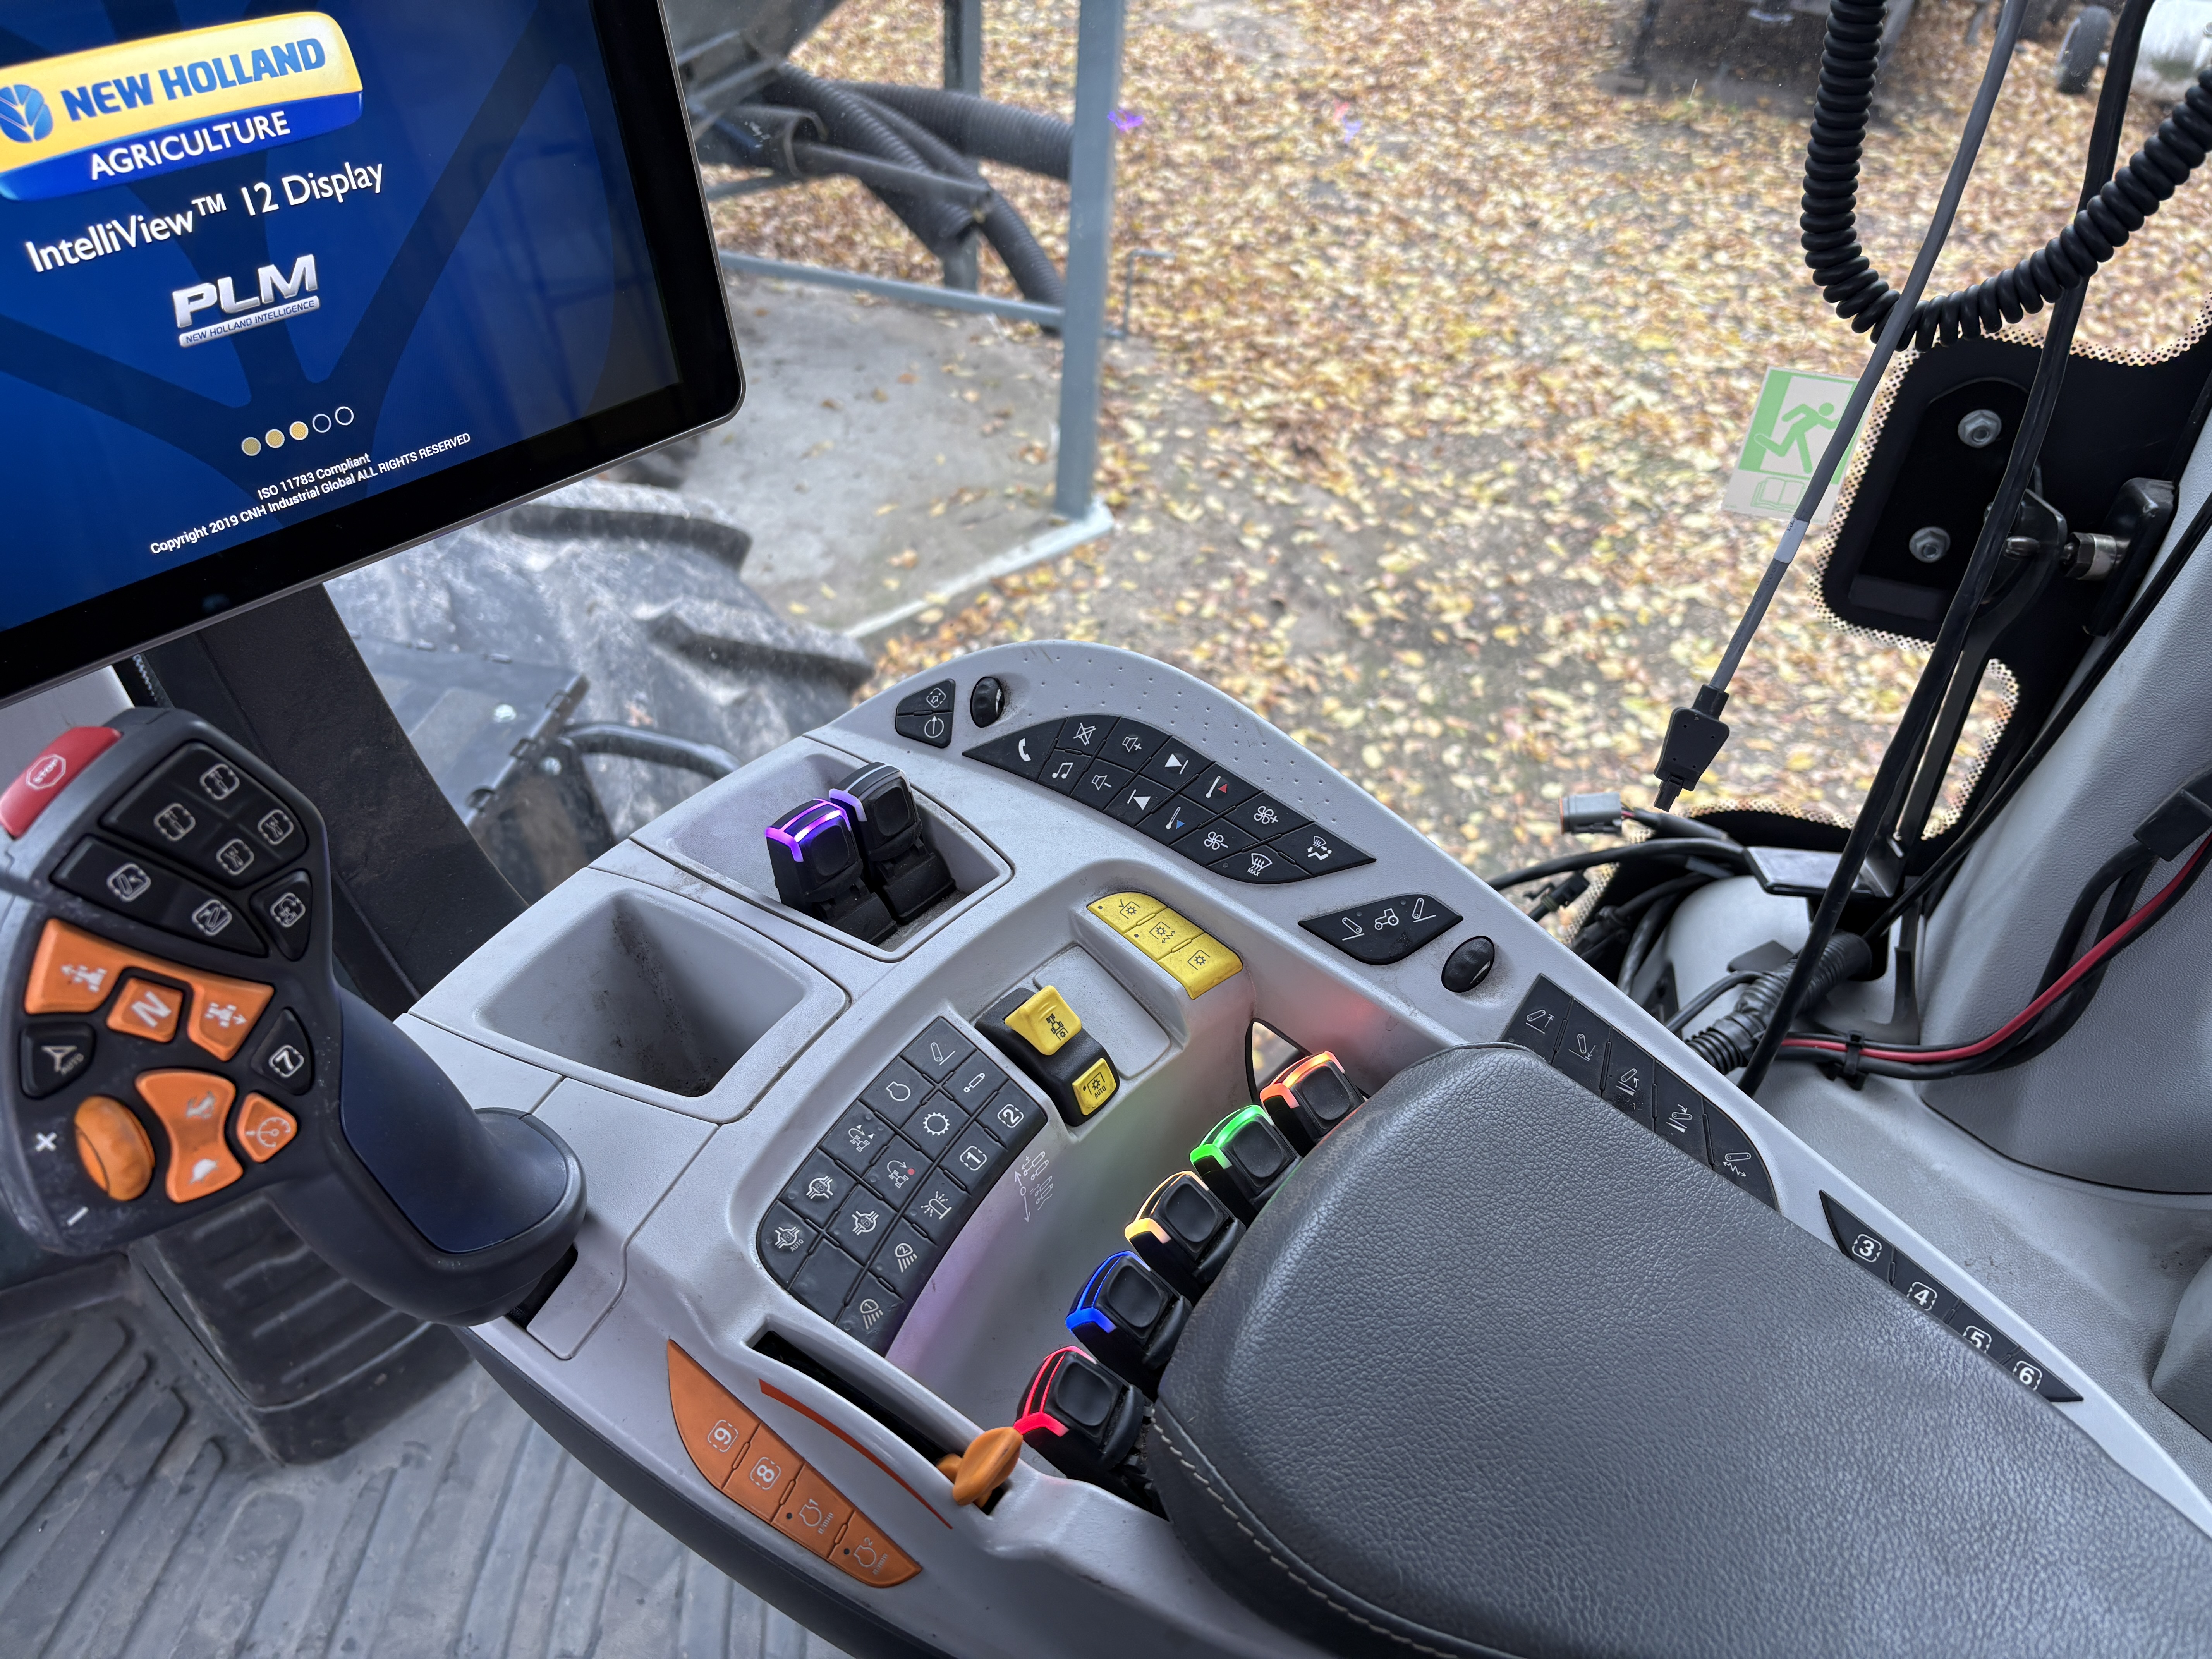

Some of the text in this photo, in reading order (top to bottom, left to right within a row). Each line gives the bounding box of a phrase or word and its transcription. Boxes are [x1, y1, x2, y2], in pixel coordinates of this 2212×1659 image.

[60, 38, 326, 121] NEW HOLLAND
[91, 111, 291, 180] AGRICULTURE
[282, 162, 383, 203] Display
[172, 254, 319, 328] PLM
[186, 300, 315, 344] NEW HOLLAND INTELLIGENCE
[258, 453, 371, 500] ISO 11783 Compliant
[150, 433, 471, 554] Copyright 2019 CNH Industrial Global ALL RIGHTS RESERVED
[1247, 867, 1260, 876] MAX
[132, 991, 172, 1027] N
[276, 1053, 294, 1071] 7
[1094, 1085, 1106, 1099] AUTO
[1003, 1109, 1020, 1124] 2
[967, 1151, 981, 1164] 1
[790, 1239, 804, 1252] AUTO
[1859, 1240, 1875, 1256] 3
[1914, 1289, 1929, 1305] 4
[1970, 1331, 1985, 1349] 5
[2019, 1367, 2035, 1385] 6
[714, 1427, 732, 1444] 9
[757, 1465, 775, 1482] 8
[864, 1537, 873, 1546] 2
